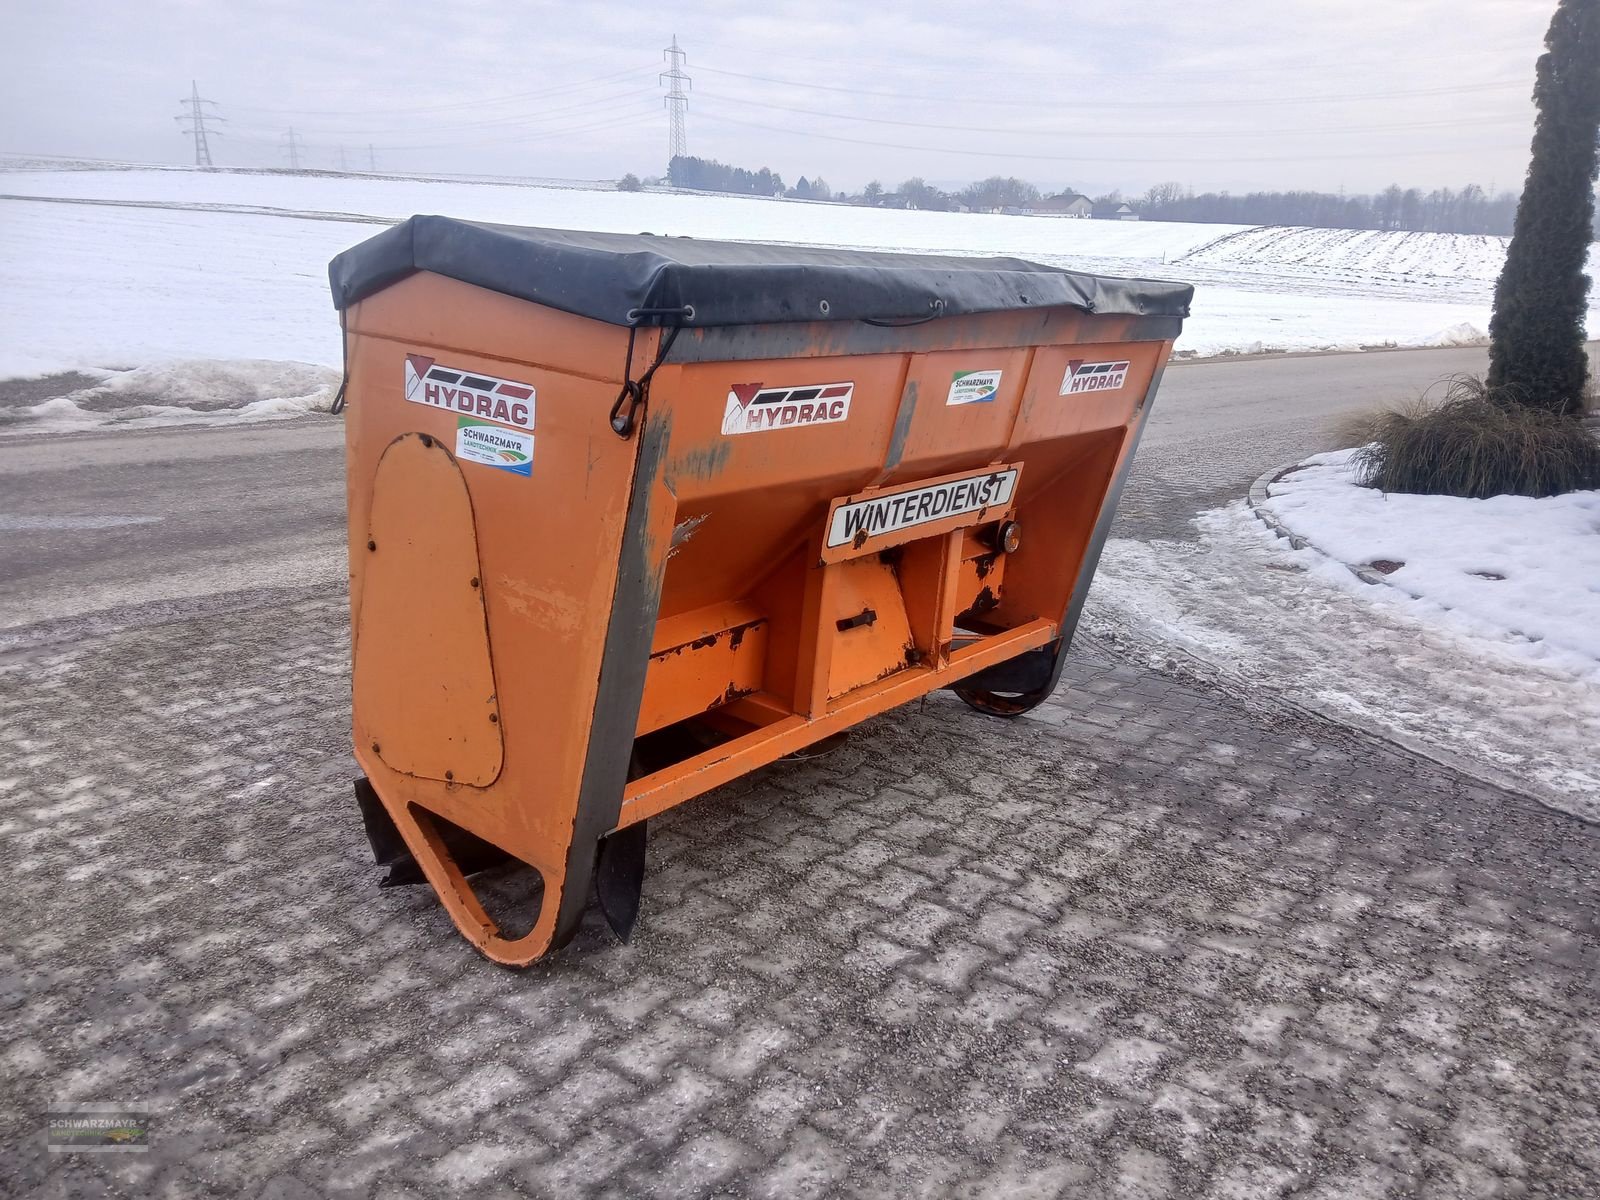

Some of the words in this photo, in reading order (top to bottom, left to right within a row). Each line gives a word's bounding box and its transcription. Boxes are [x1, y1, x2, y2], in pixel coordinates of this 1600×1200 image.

[956, 378, 994, 388] SCHWARZMAYR
[1070, 373, 1123, 392] HYDRAC
[425, 383, 528, 425] HYDRAC
[746, 401, 844, 429] HYDRAC
[463, 428, 522, 452] SCHWARZMAYR
[463, 439, 497, 454] LANDTECHNIK
[844, 476, 1007, 538] WINTERDIENST
